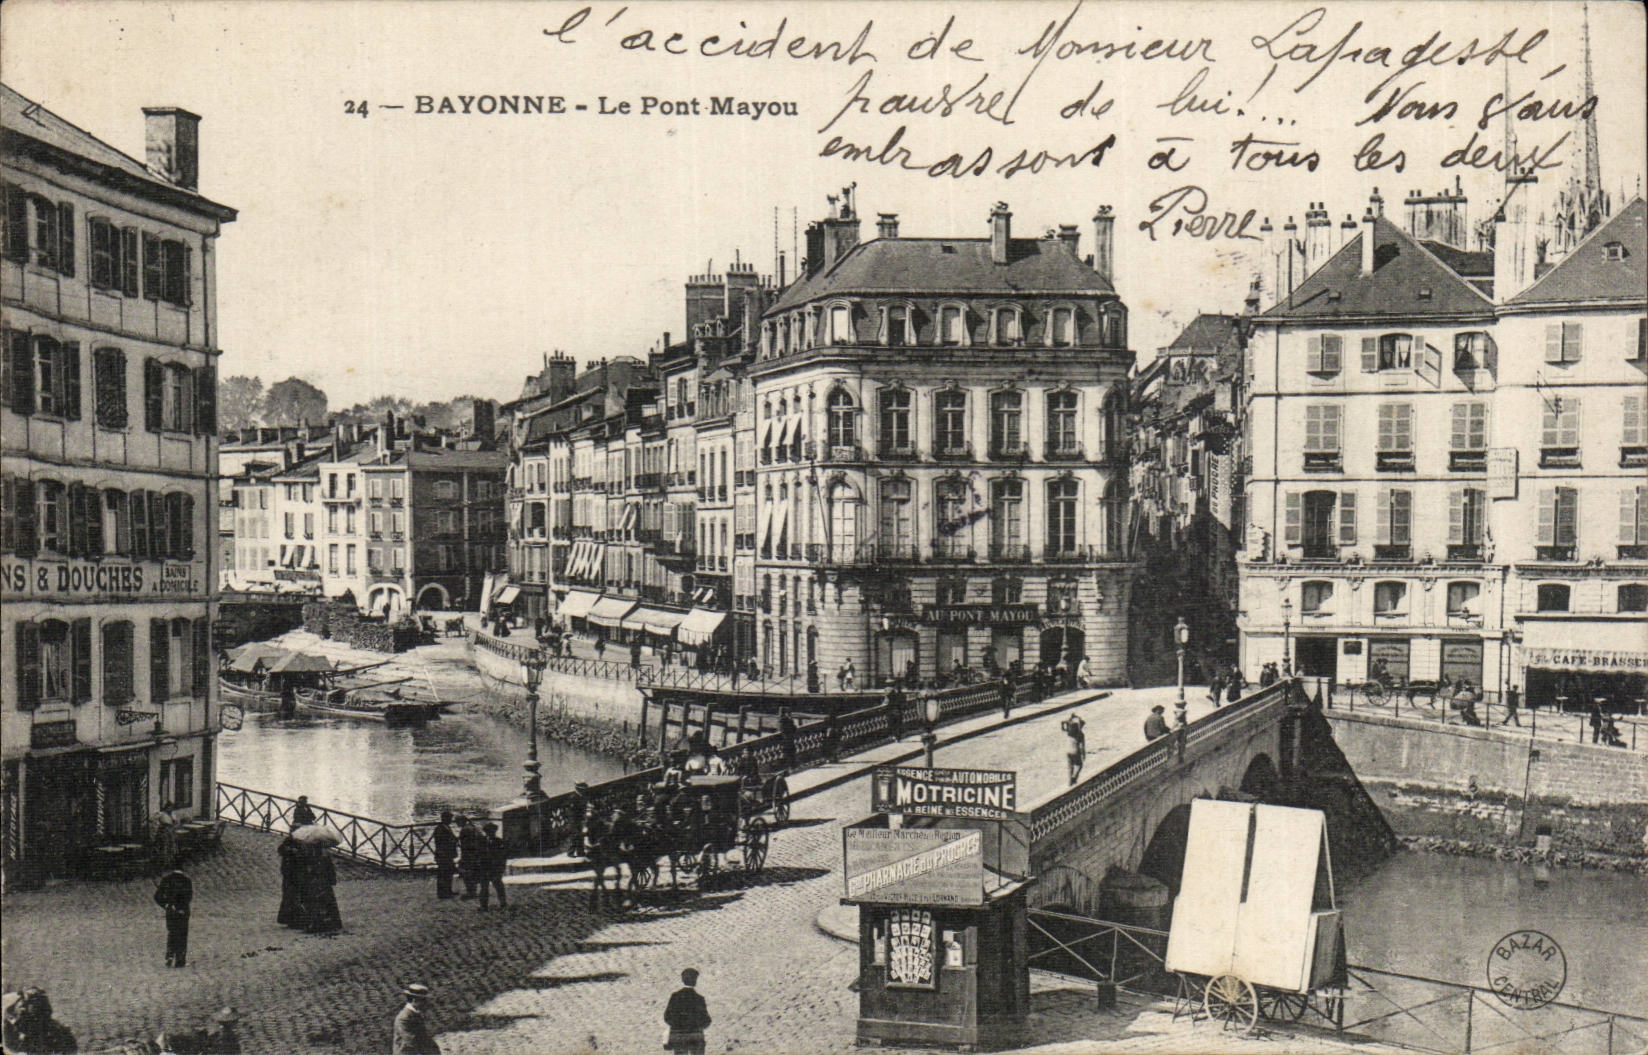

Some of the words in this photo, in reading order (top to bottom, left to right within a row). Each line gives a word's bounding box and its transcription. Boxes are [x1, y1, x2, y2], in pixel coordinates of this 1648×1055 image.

[908, 15, 983, 62] de
[1004, 0, 1216, 100] Monsieur
[1060, 80, 1115, 120] de
[1230, 133, 1320, 172] tous
[1354, 133, 1406, 173] les
[1440, 131, 1574, 175] deux
[1138, 185, 1264, 242] Pierre
[37, 566, 49, 591] &
[57, 565, 144, 592] DOUCHES
[926, 610, 944, 622] AU
[949, 610, 983, 622] PONT
[989, 610, 1033, 622] MAYOU
[896, 777, 1015, 810] MOTRICINE
[951, 771, 1012, 784] AUTOMOBILES
[915, 806, 944, 815] REINE
